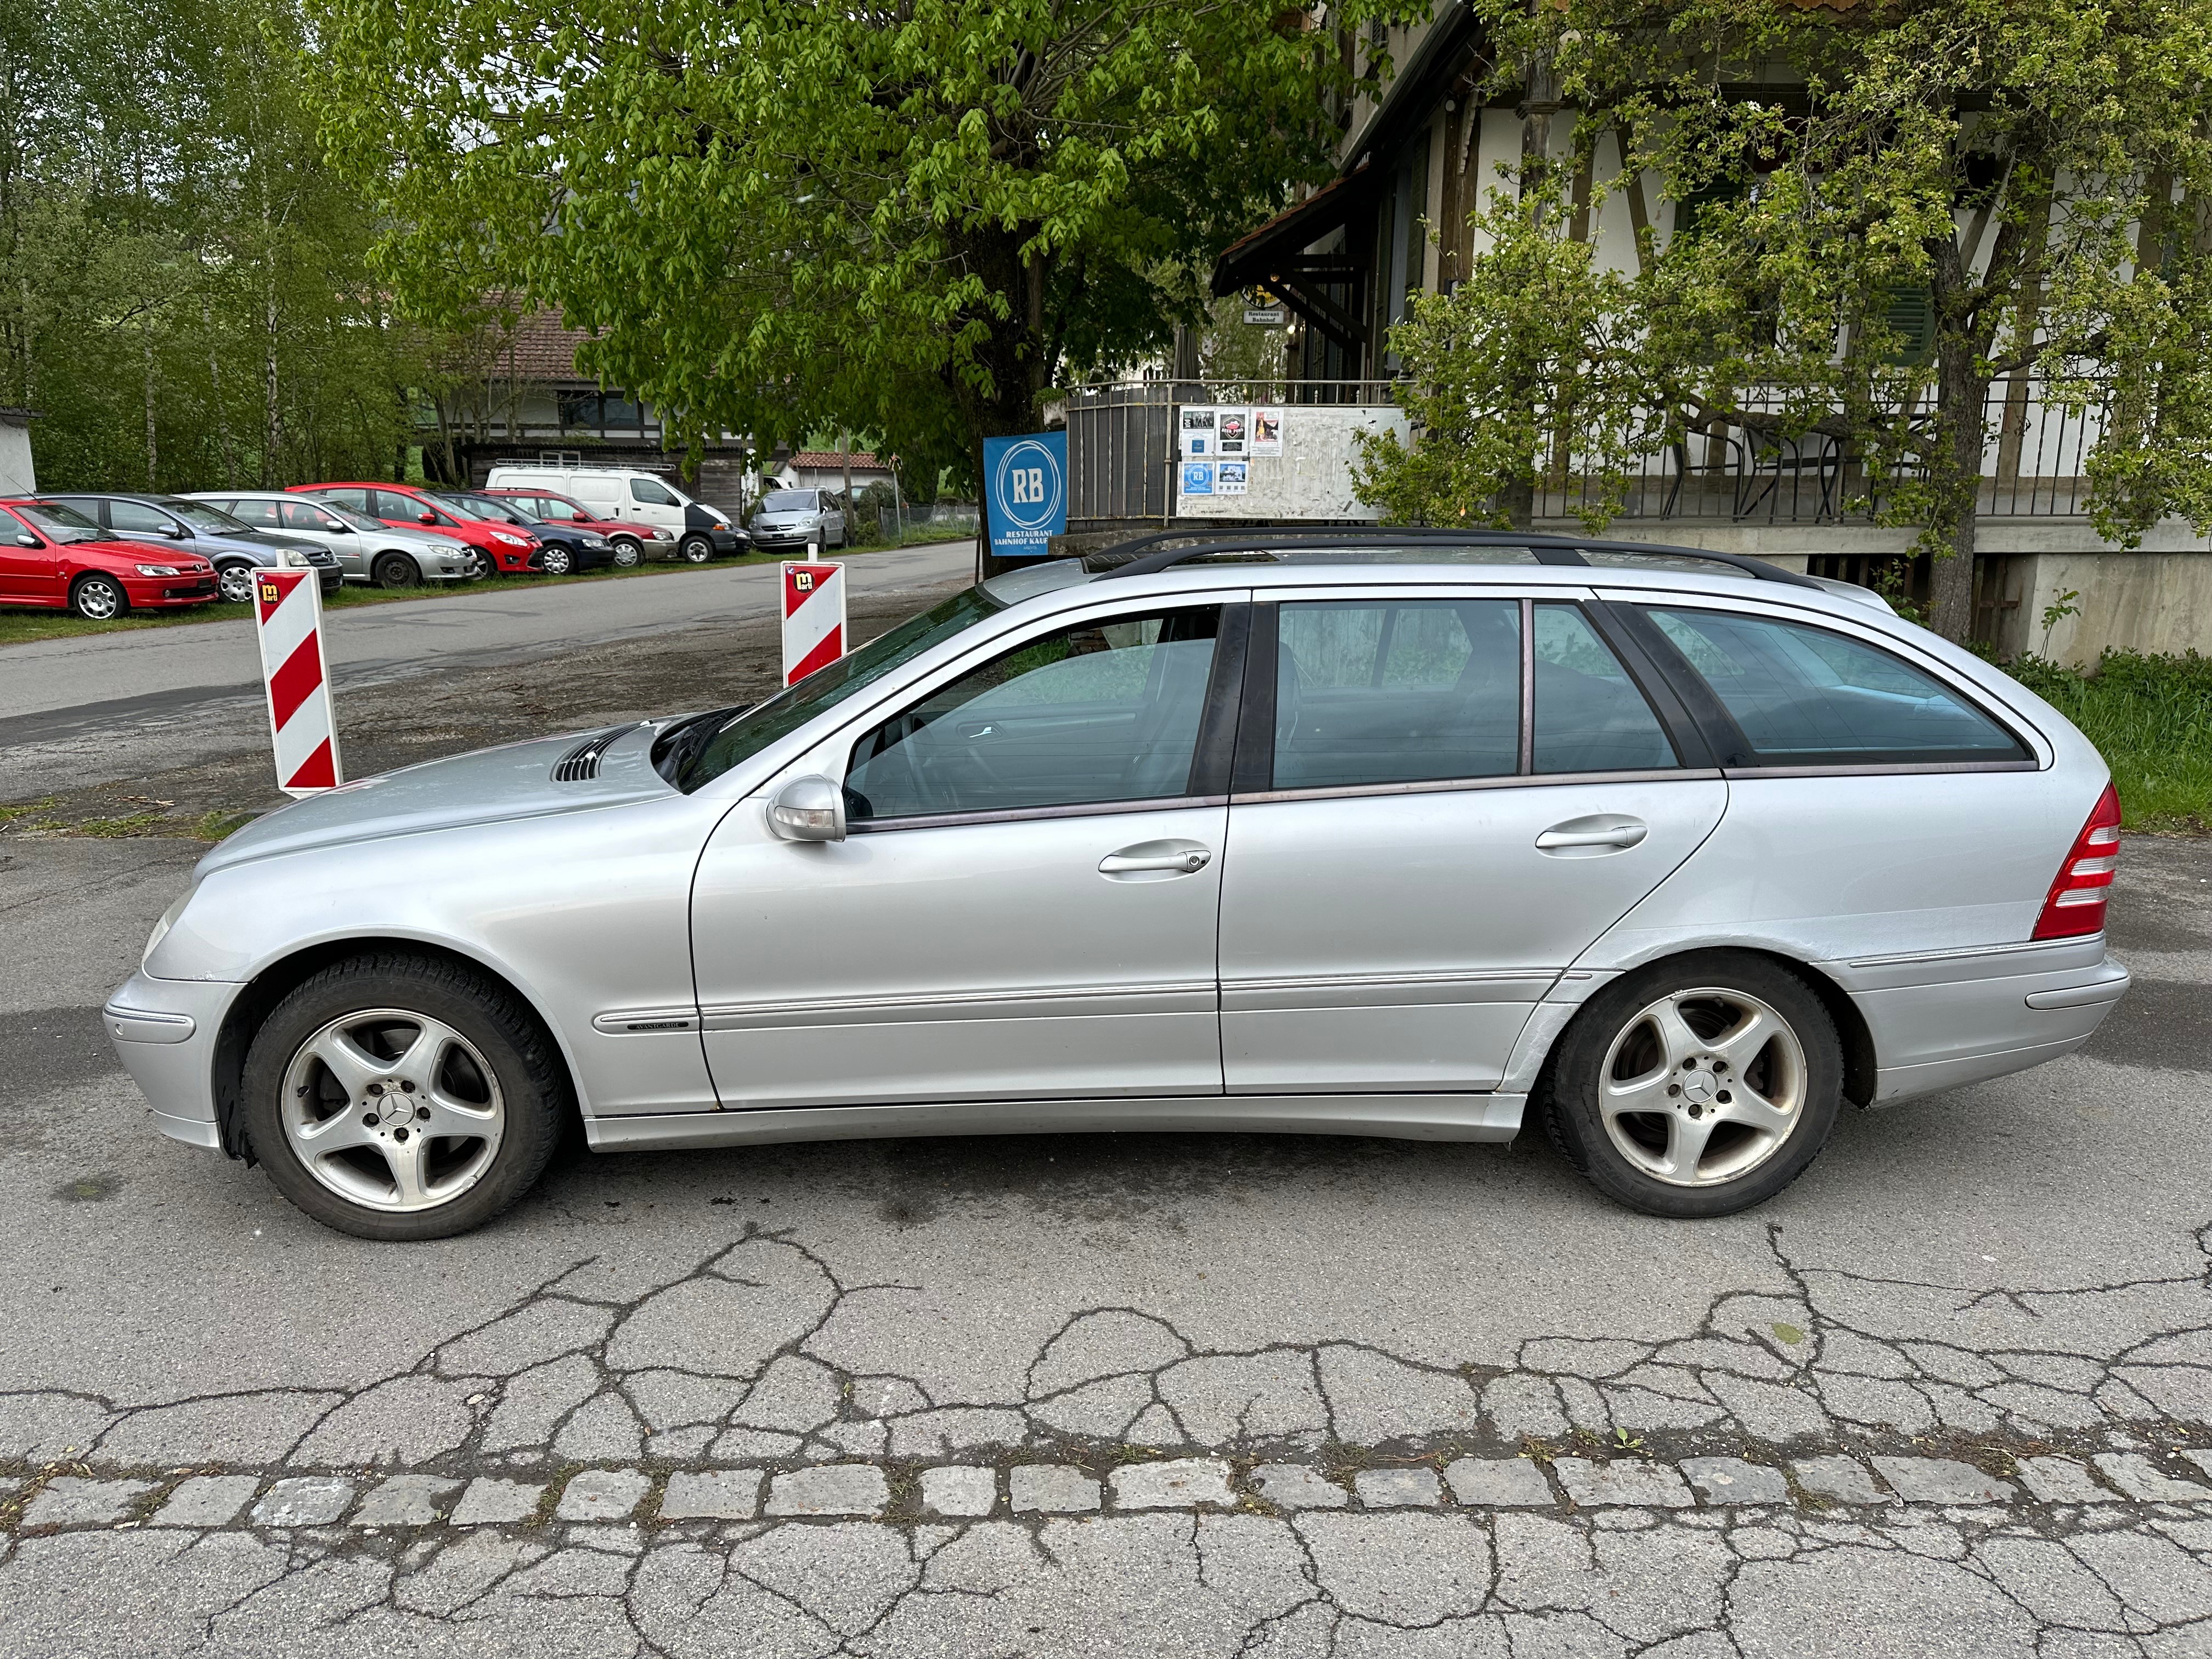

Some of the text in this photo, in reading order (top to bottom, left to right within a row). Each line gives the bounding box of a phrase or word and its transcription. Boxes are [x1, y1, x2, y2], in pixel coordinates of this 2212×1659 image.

[1193, 471, 1204, 481] RB
[1012, 467, 1044, 503] RB
[262, 584, 278, 601] marti
